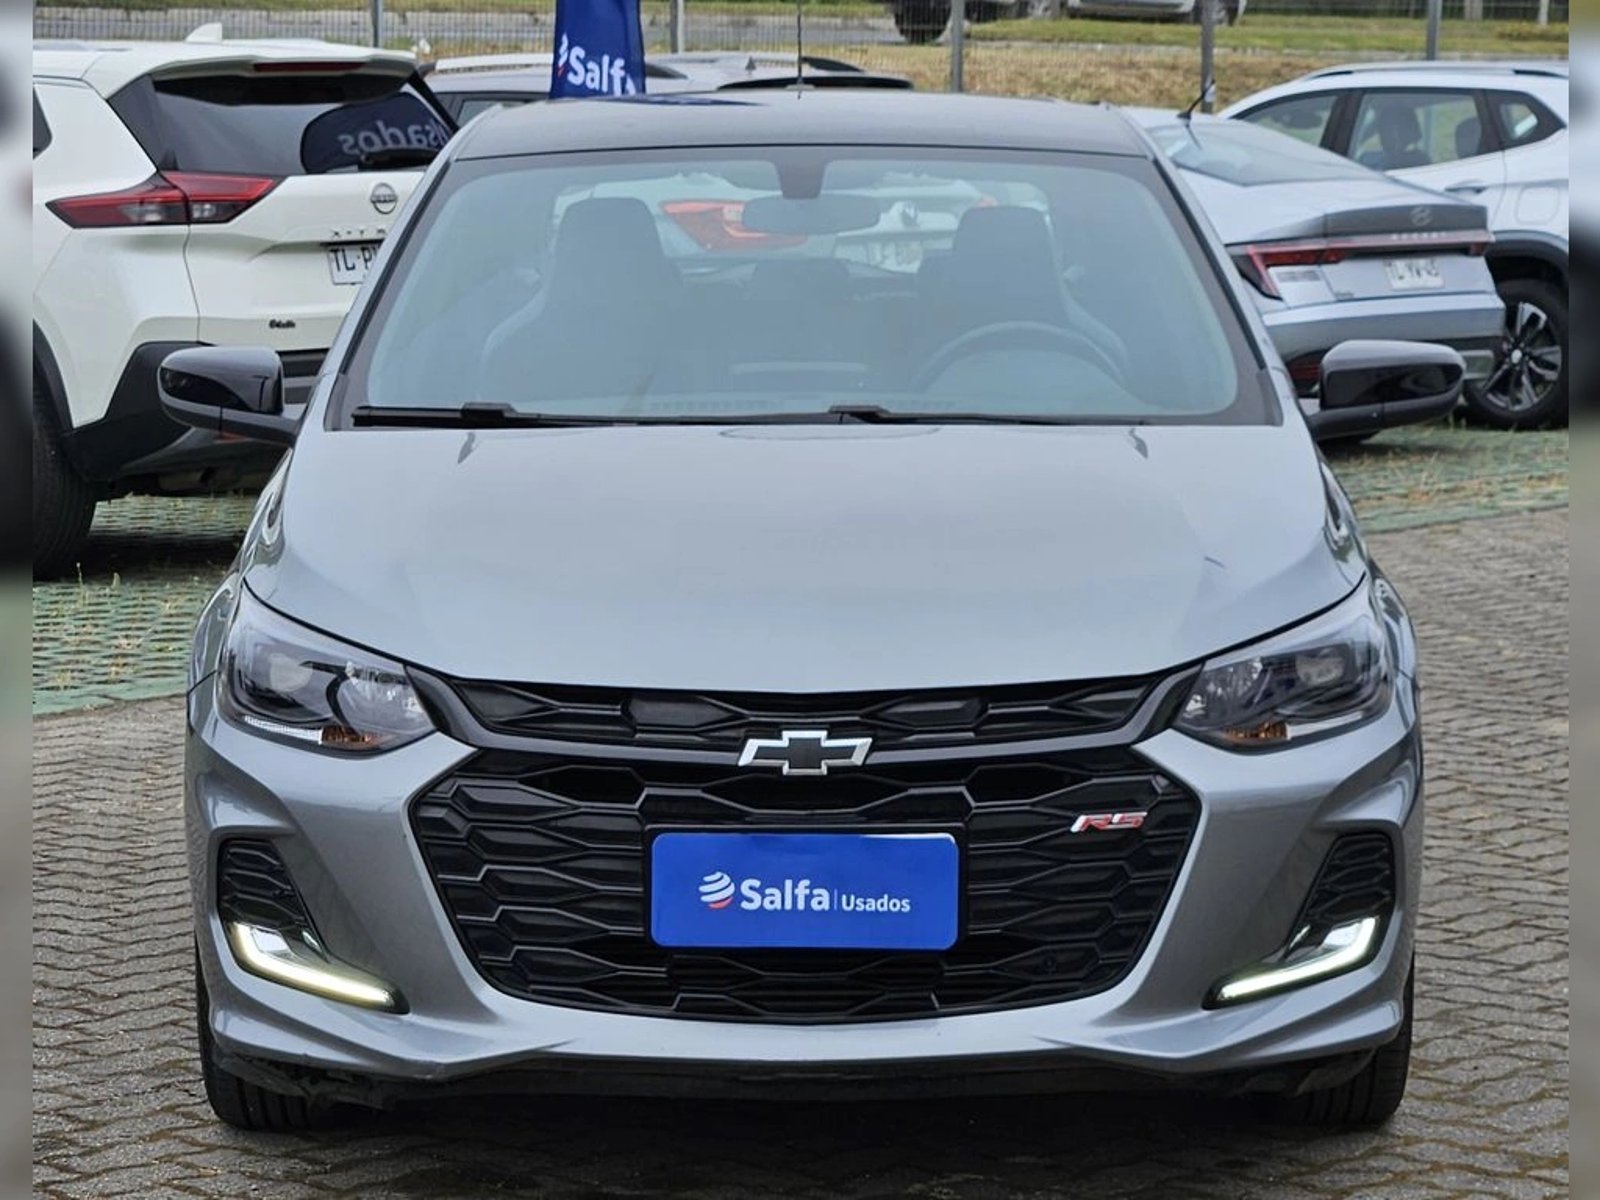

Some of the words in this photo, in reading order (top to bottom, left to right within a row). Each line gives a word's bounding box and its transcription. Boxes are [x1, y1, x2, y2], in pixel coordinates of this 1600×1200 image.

[1070, 811, 1148, 833] RS
[740, 878, 830, 911] Salfa
[841, 894, 911, 912] Usados
